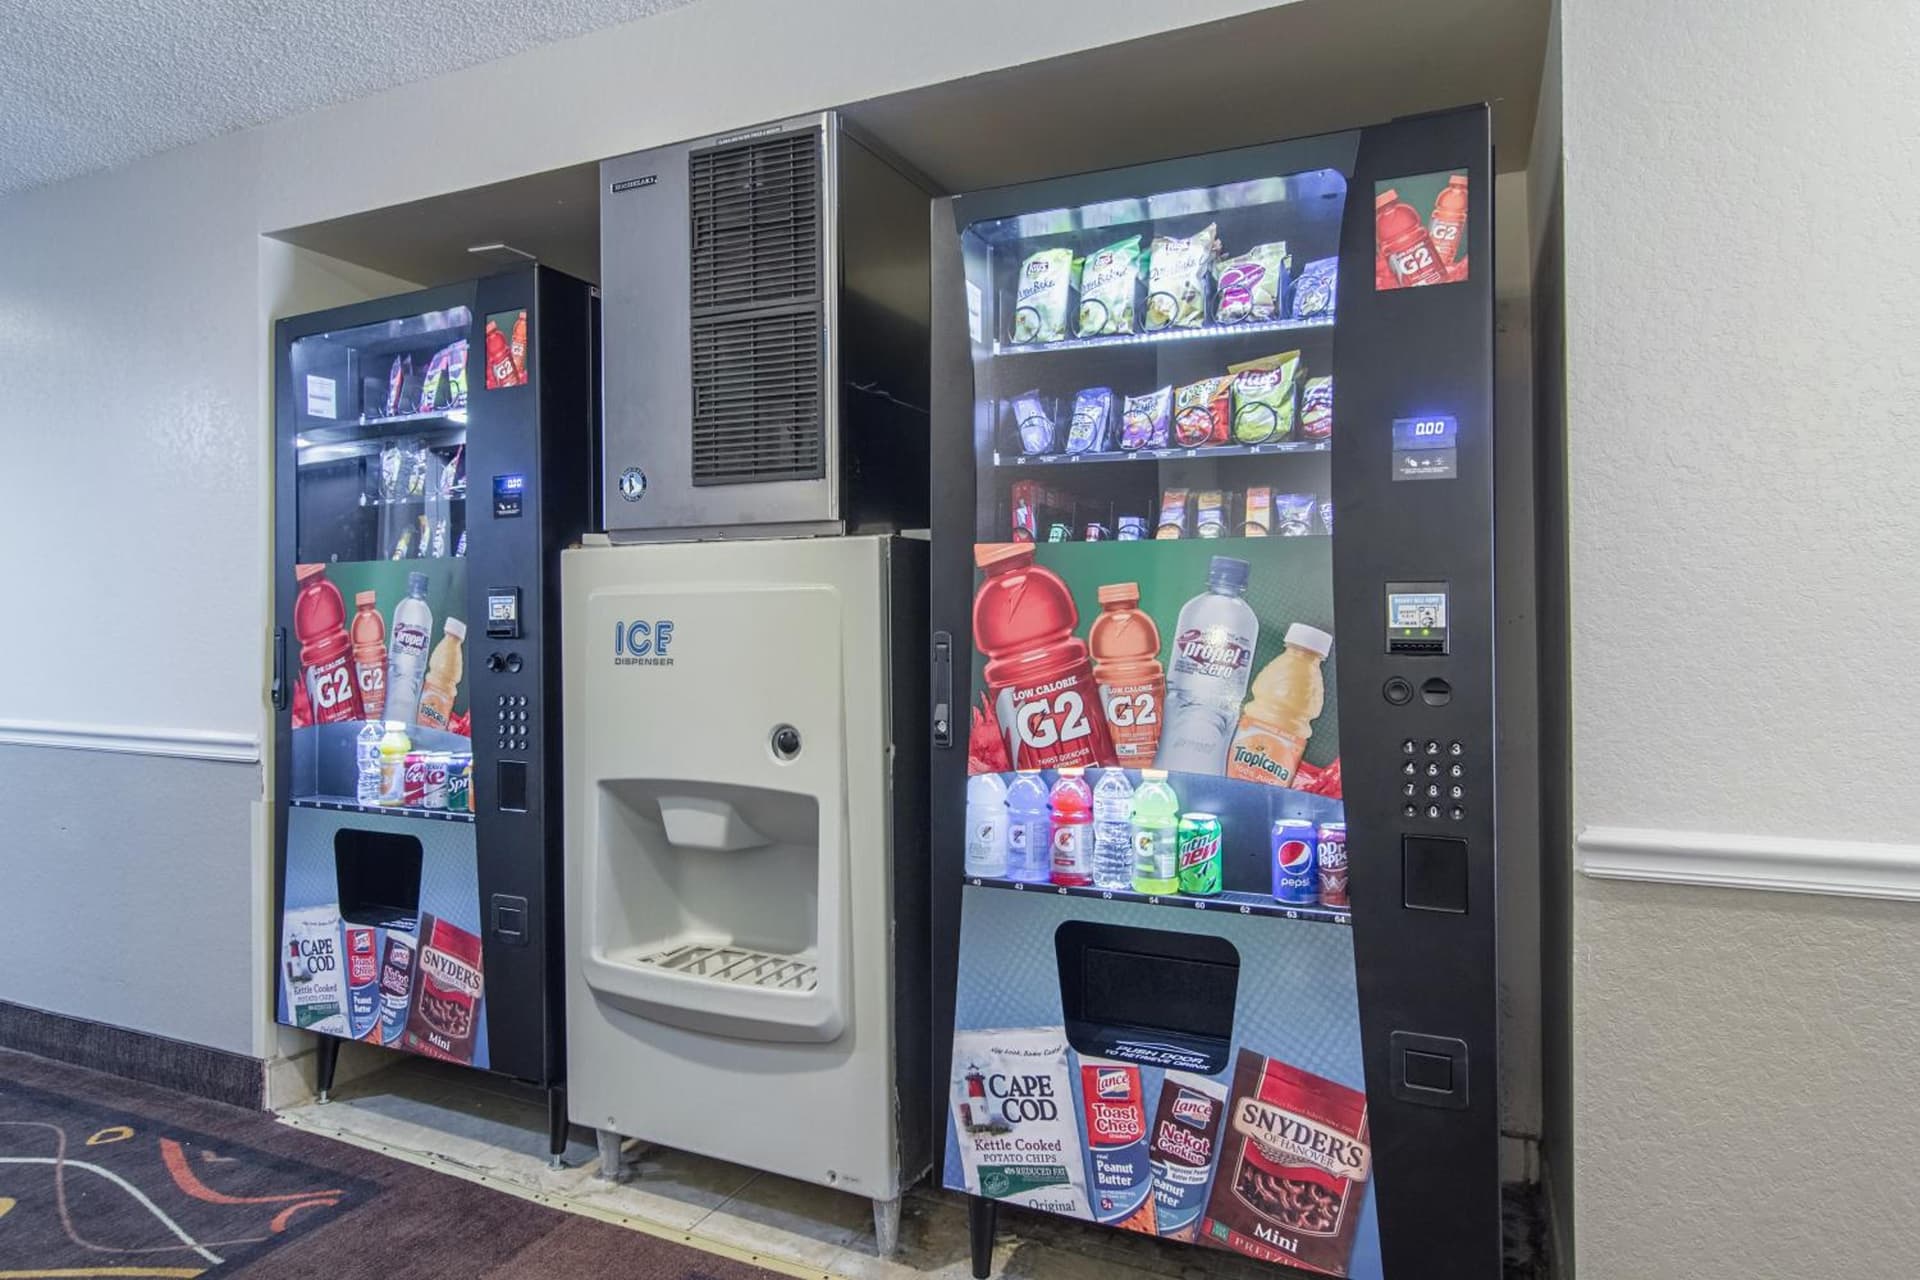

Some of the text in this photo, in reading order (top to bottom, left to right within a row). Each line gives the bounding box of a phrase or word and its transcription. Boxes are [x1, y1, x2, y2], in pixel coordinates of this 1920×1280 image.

[1431, 226, 1458, 240] G2
[1398, 247, 1433, 275] G2
[614, 657, 675, 667] DISPENSER
[1201, 663, 1233, 679] zero
[317, 667, 353, 709] G2
[360, 668, 384, 692] G2
[1013, 676, 1078, 701] LOW CALORIE
[1017, 690, 1091, 748] G2
[1108, 693, 1157, 727] G2
[1406, 742, 1461, 755] 1 2 3
[1234, 746, 1290, 781] Tropicana
[1406, 763, 1461, 776] 4 5 6
[1407, 784, 1461, 797] 7 8 9
[1281, 878, 1310, 888] pepsi
[300, 938, 334, 957] CAPE
[307, 955, 335, 974] COD
[423, 949, 481, 990] SNYDER'S
[428, 1032, 451, 1051] Mini
[1116, 1045, 1205, 1064] PUSH DOOR
[1120, 1051, 1172, 1064] RETRIEVE
[988, 1074, 1054, 1099] CAPE
[1001, 1098, 1058, 1123] COD
[1092, 1103, 1138, 1121] Toast
[1173, 1100, 1213, 1116] Lance
[1095, 1118, 1139, 1135] Chee
[1242, 1103, 1364, 1169] SNYDER'S
[975, 1138, 1062, 1151] Kettle Cooked
[1160, 1121, 1211, 1155] Nekot
[983, 1153, 1057, 1163] POTATO CHIPS
[1157, 1137, 1206, 1165] Cookies
[1263, 1132, 1335, 1168] OF HANOVER
[1096, 1159, 1133, 1174] Peanut
[1098, 1173, 1133, 1187] Butter
[1152, 1177, 1185, 1198] eanut
[1028, 1199, 1076, 1213] Original
[1254, 1223, 1299, 1254] Mini
